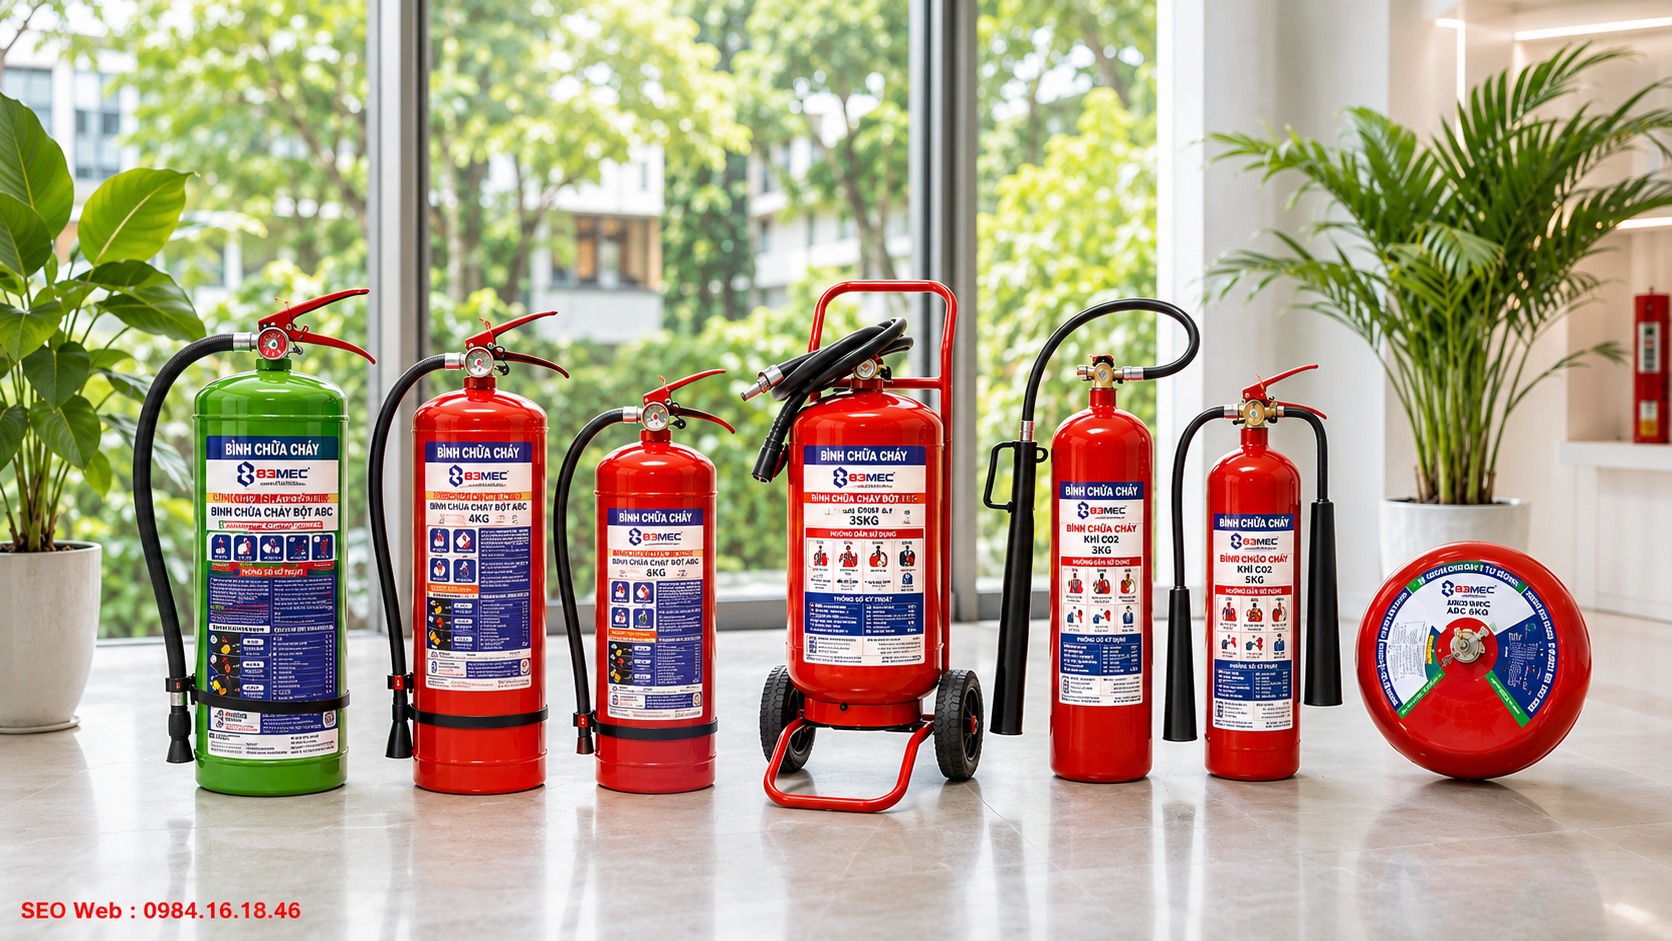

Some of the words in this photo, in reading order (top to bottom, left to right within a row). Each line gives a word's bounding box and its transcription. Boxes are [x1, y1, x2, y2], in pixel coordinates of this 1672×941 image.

[226, 440, 251, 455] BÌNH
[254, 440, 287, 455] CHỮA
[290, 440, 319, 455] CHÁY
[437, 444, 460, 458] BÌNH
[494, 444, 519, 458] CHÁY
[821, 448, 844, 461] BÌNH
[880, 448, 907, 461] CHÁY
[1066, 484, 1085, 496] BÌNH
[469, 514, 489, 523] 4KG
[620, 510, 639, 522] BÌNH
[1220, 516, 1238, 527] BÌNH
[1092, 546, 1112, 554] 3KG
[646, 568, 666, 577] 8KG
